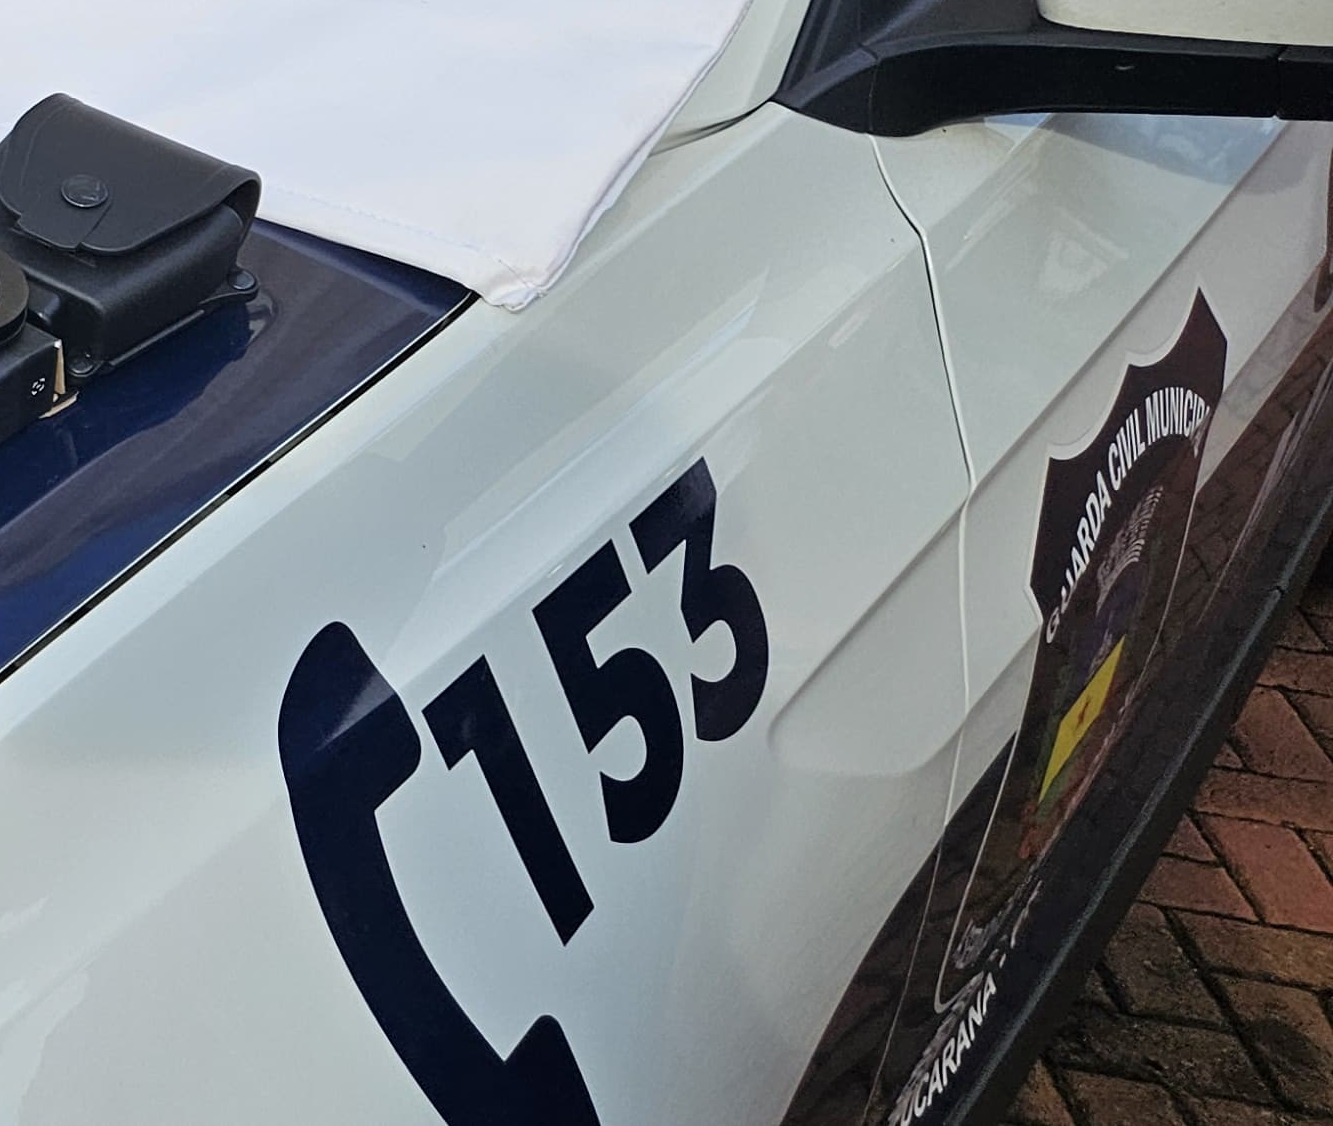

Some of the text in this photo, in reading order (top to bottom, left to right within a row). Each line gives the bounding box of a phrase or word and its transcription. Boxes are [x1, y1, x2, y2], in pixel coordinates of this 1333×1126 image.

[419, 455, 770, 947] 153
[1045, 469, 1113, 644] GUARDA
[1107, 407, 1146, 491] CIVIL
